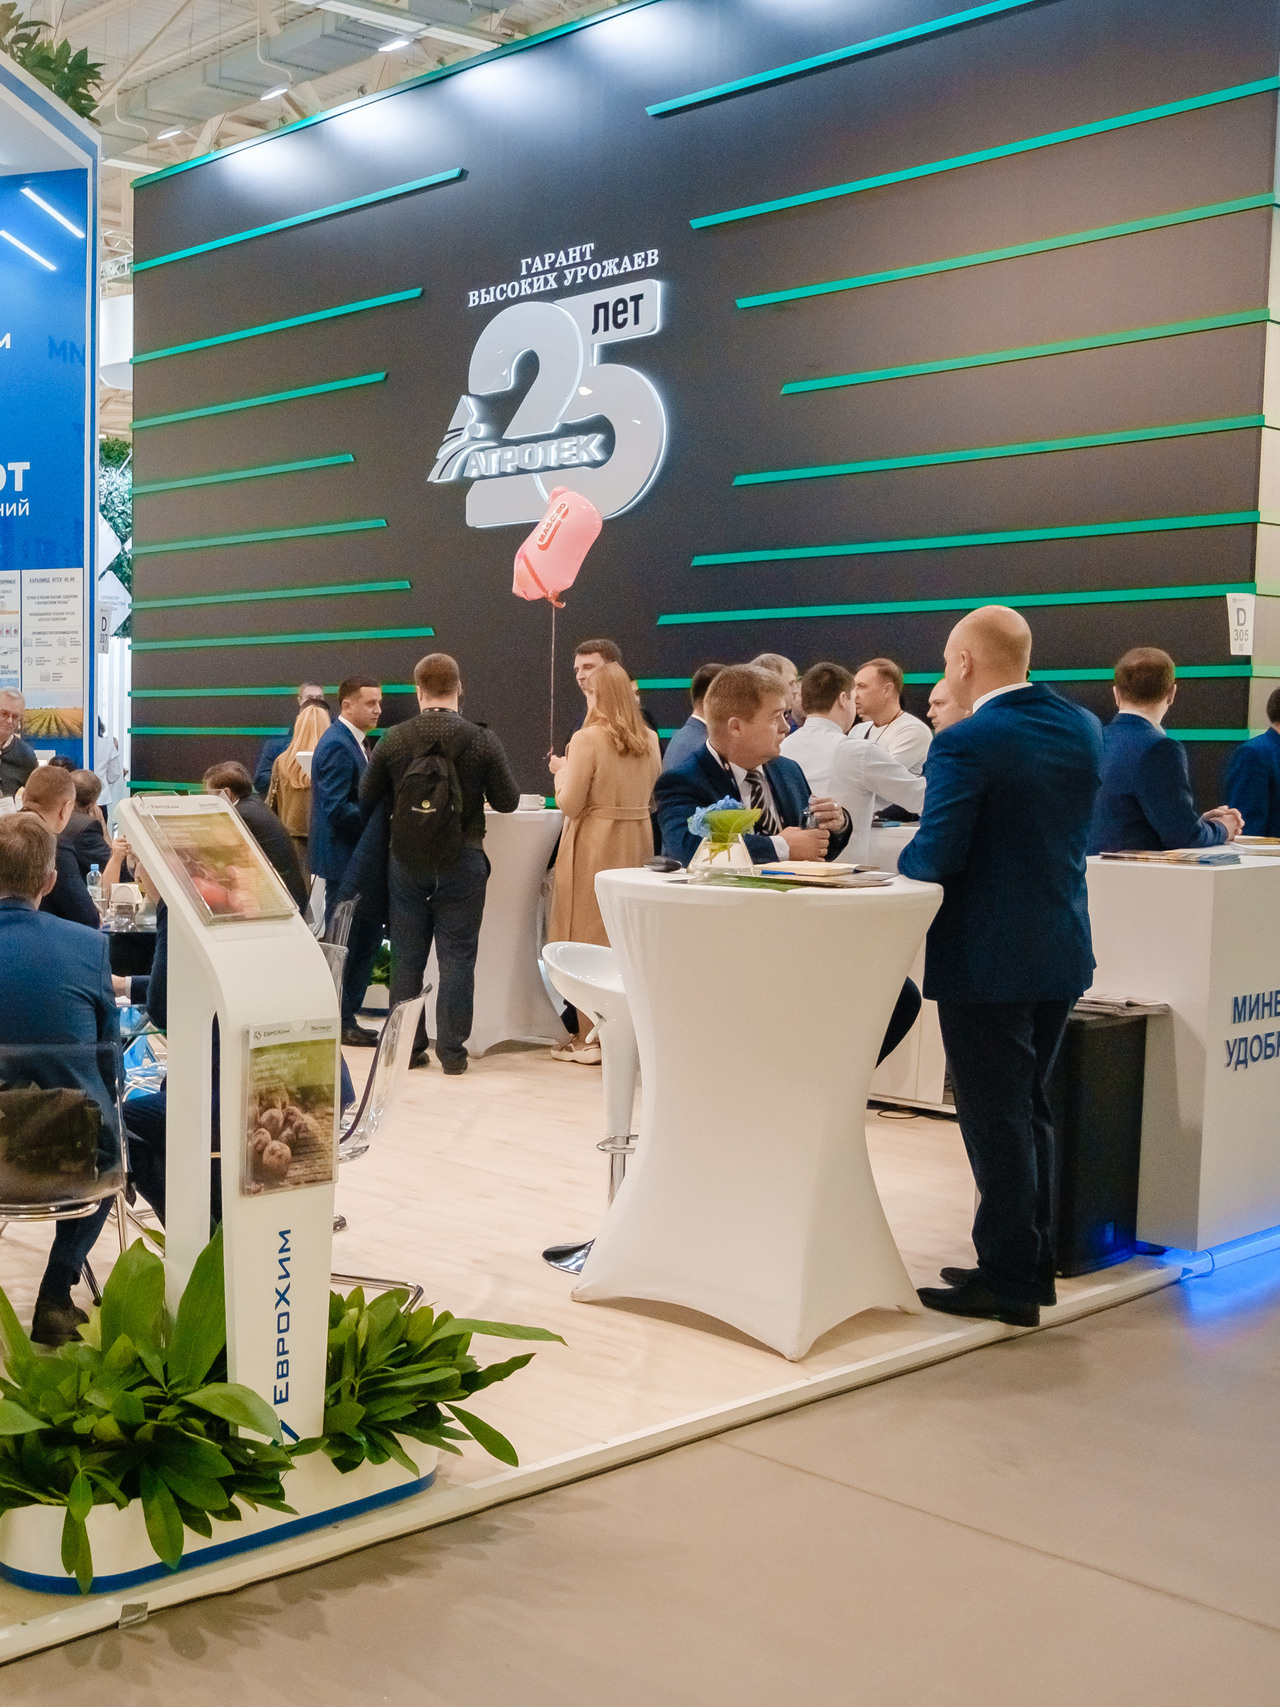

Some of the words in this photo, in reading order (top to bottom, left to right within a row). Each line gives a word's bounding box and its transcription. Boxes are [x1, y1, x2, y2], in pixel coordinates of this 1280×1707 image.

[520, 243, 594, 276] ГАРАНТ
[468, 272, 558, 308] ВЫСОКИХ
[563, 249, 659, 287] УРОЖАЕВ
[591, 293, 644, 335] лет
[464, 433, 606, 479] АГРОТЕК
[101, 616, 108, 632] D
[1233, 629, 1249, 642] 305
[1236, 607, 1247, 627] D
[273, 1228, 292, 1406] ЕвроХим
